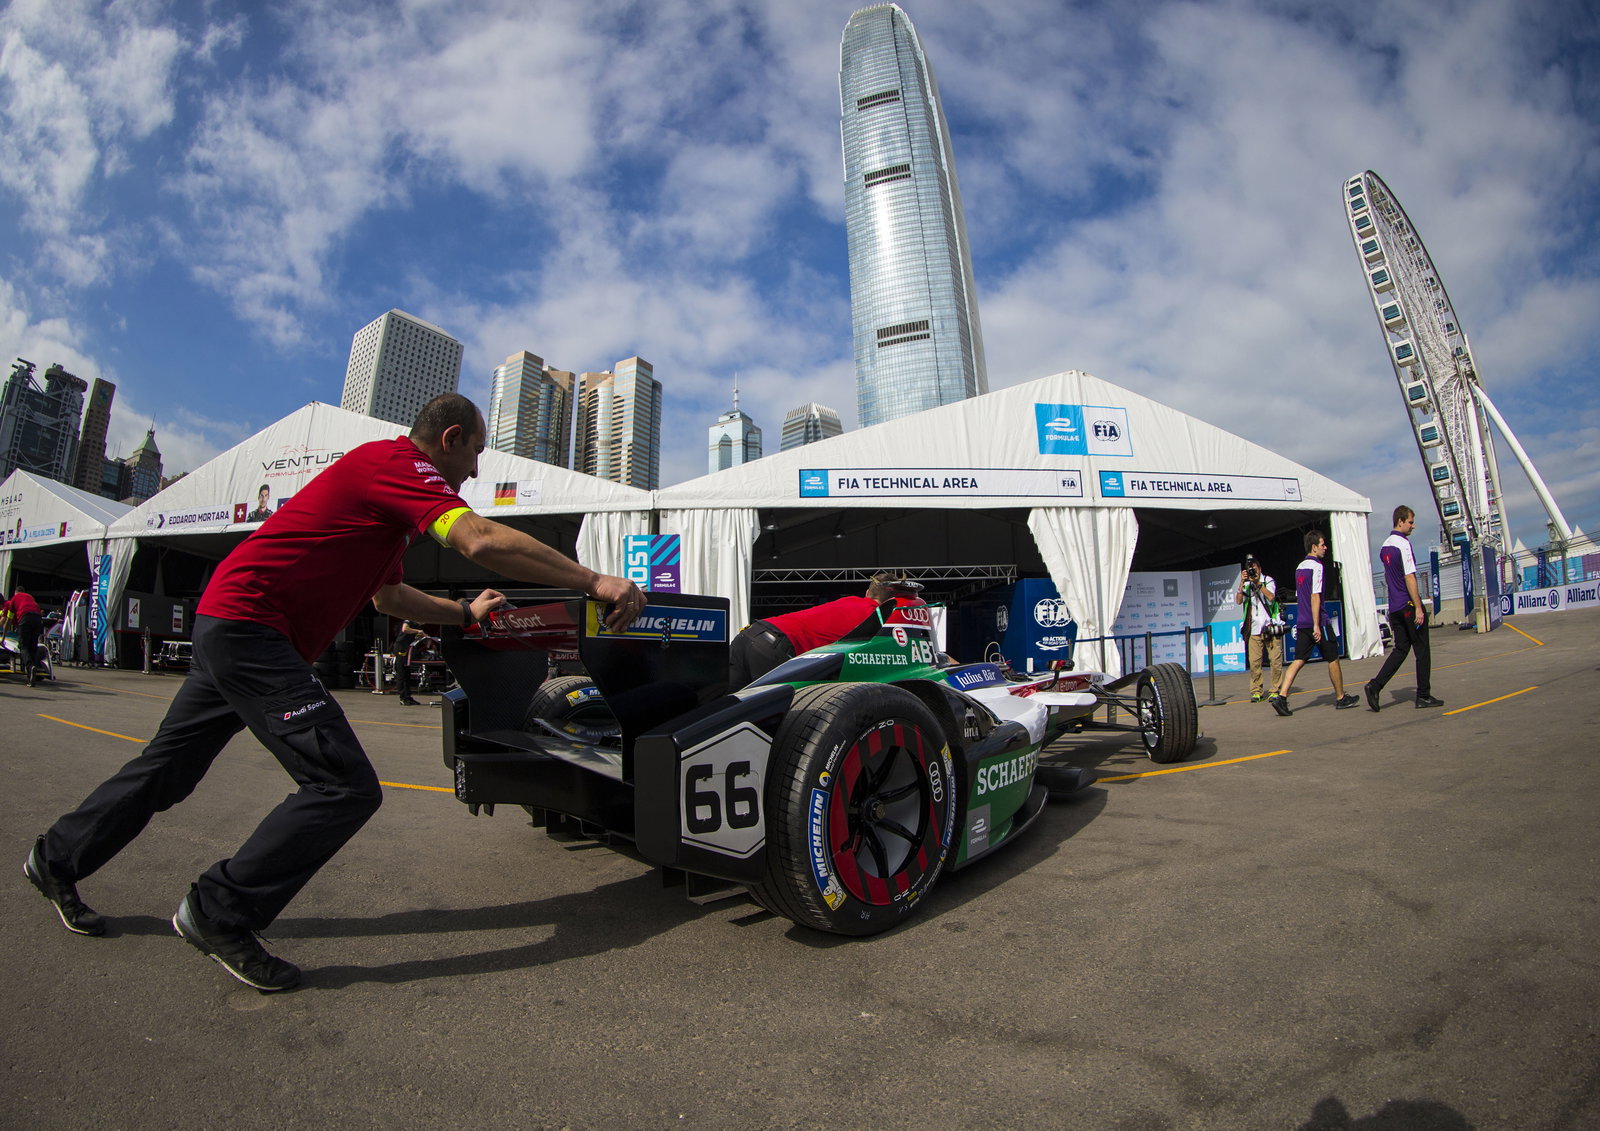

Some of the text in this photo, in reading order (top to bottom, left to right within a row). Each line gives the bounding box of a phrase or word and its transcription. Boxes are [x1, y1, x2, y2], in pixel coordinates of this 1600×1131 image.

[838, 477, 979, 489] FIA TECHNICAL AREA
[1130, 480, 1233, 493] FIA TECHNICAL AREA
[199, 510, 230, 522] MORTARA
[440, 513, 450, 525] 20
[628, 535, 648, 590] OST
[1207, 588, 1234, 606] HKG
[1518, 594, 1547, 609] Allianz
[1567, 587, 1596, 603] Allianz
[895, 629, 906, 643] E
[848, 652, 909, 665] SCHAEFFLER
[955, 669, 996, 688] Julius Bär
[291, 700, 326, 717] Audi Sport
[685, 760, 760, 835] 66
[812, 793, 829, 878] MICHELIN
